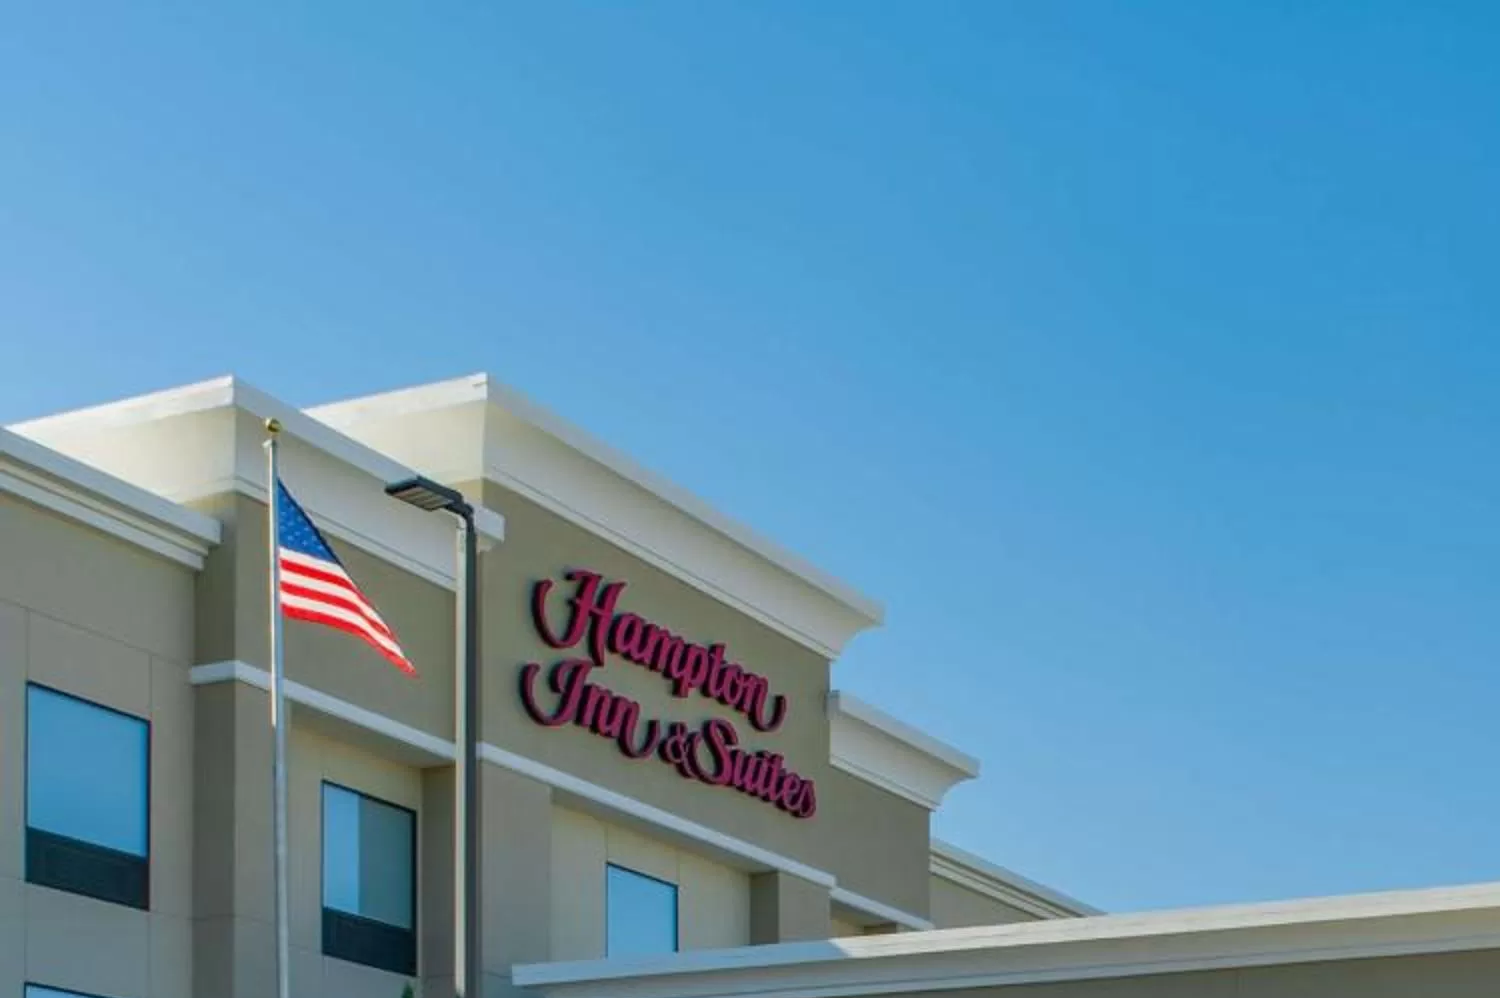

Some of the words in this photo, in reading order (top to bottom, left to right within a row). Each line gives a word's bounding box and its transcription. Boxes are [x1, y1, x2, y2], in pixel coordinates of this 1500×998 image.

[531, 569, 787, 732] Hampton
[519, 659, 661, 760] Inn
[658, 722, 688, 766] &
[679, 719, 817, 819] Suites
